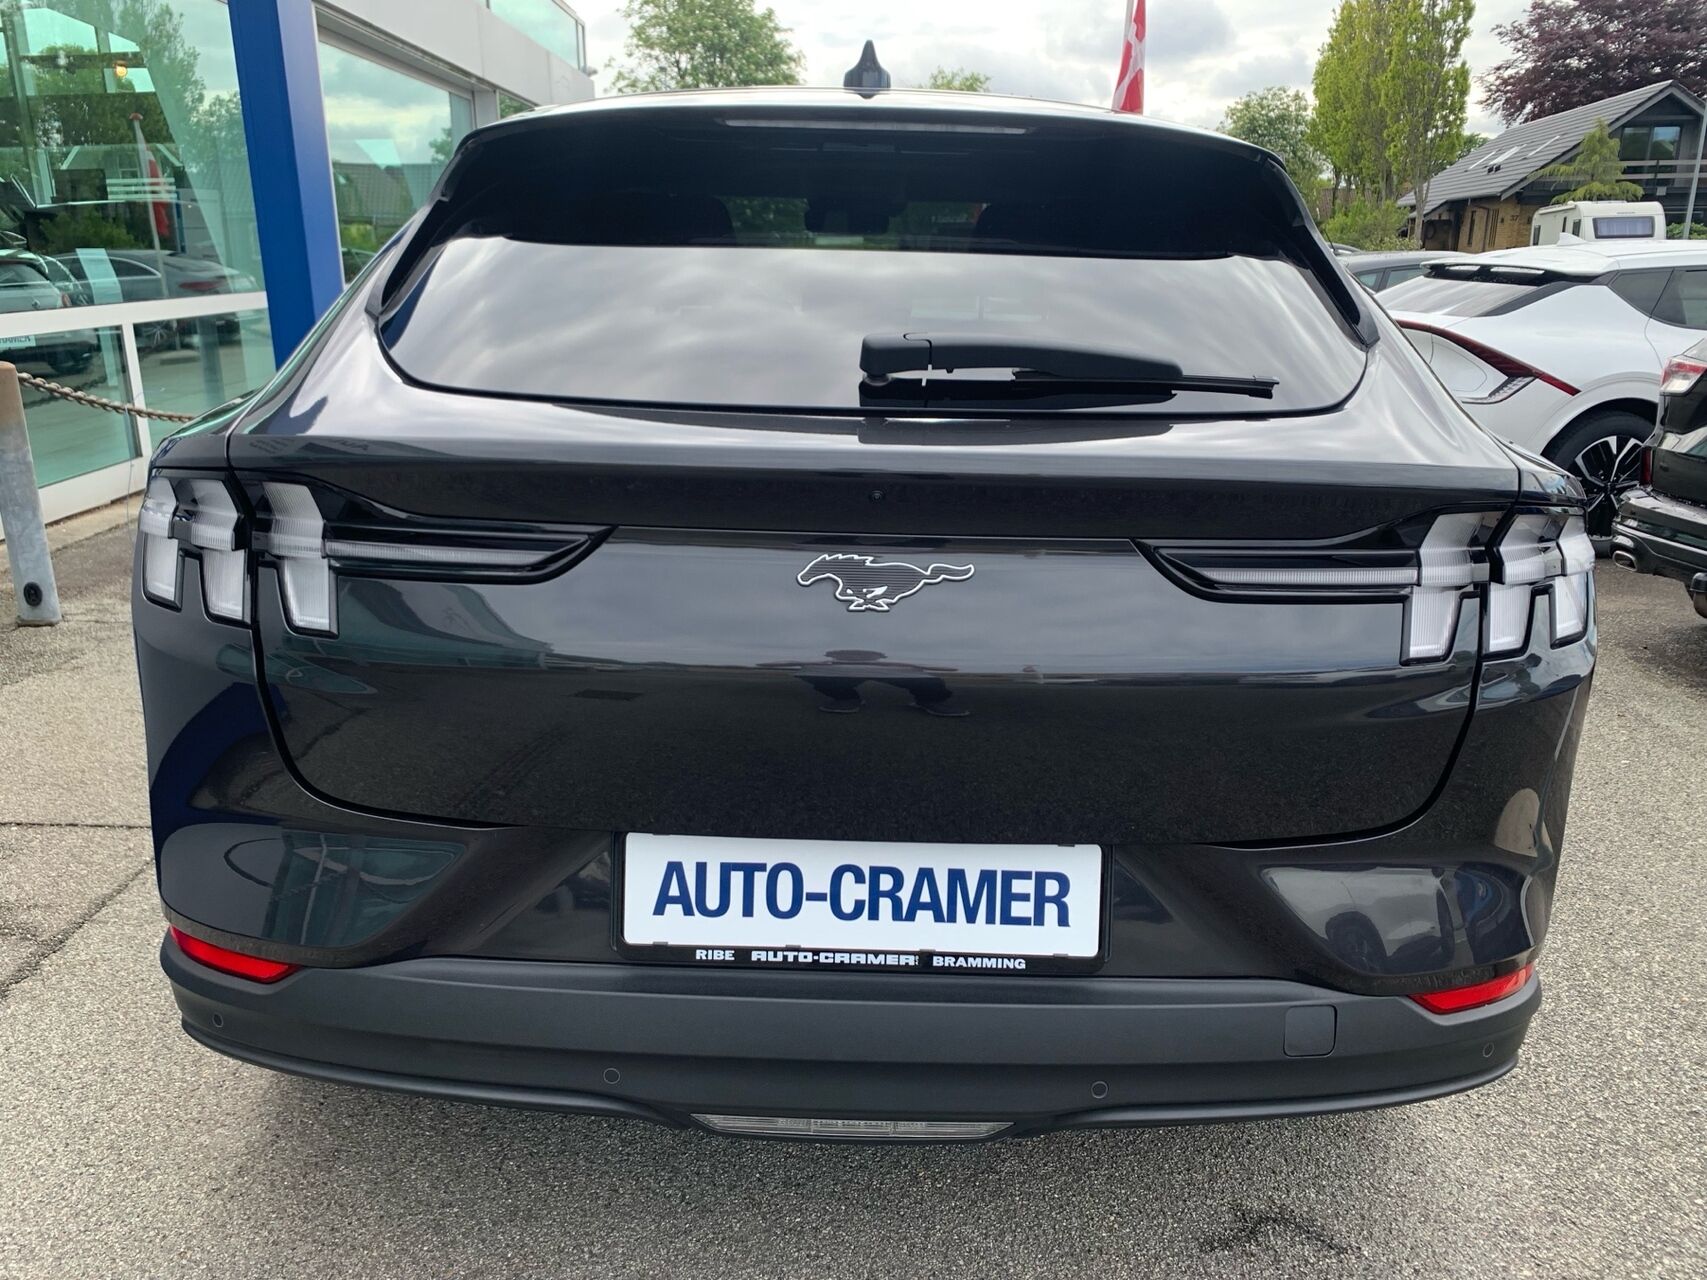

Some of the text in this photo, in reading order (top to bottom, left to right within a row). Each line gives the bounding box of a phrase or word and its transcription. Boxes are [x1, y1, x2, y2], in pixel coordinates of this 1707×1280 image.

[652, 861, 1071, 927] AUTO-CRAMER
[695, 949, 735, 961] RIBE
[751, 950, 915, 966] AUTO-CRAMER
[932, 955, 1027, 970] BRAMMING
